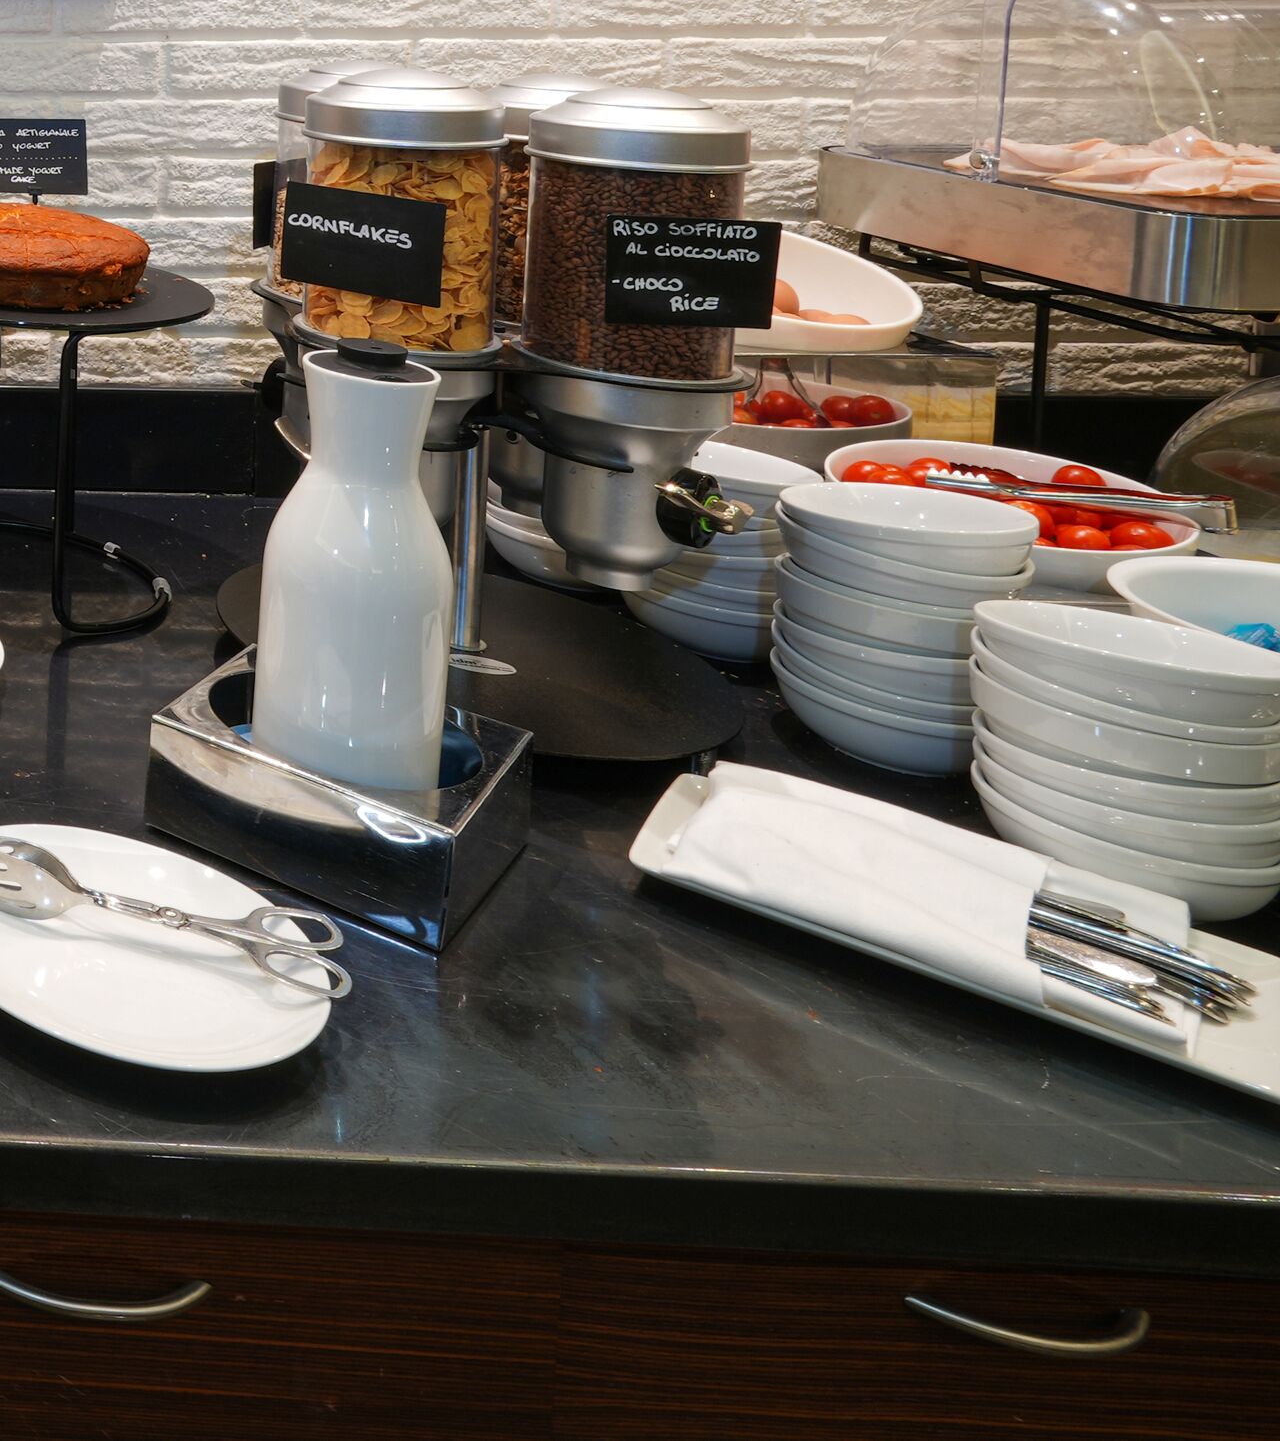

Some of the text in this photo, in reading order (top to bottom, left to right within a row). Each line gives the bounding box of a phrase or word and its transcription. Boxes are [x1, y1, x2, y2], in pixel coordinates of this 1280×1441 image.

[16, 128, 79, 137] ARTIGIANALE
[12, 142, 51, 152] YOGURT
[28, 166, 63, 176] YOGURT
[11, 175, 37, 183] CAKE
[288, 213, 412, 250] CORNFLAKES
[626, 242, 648, 255] AL
